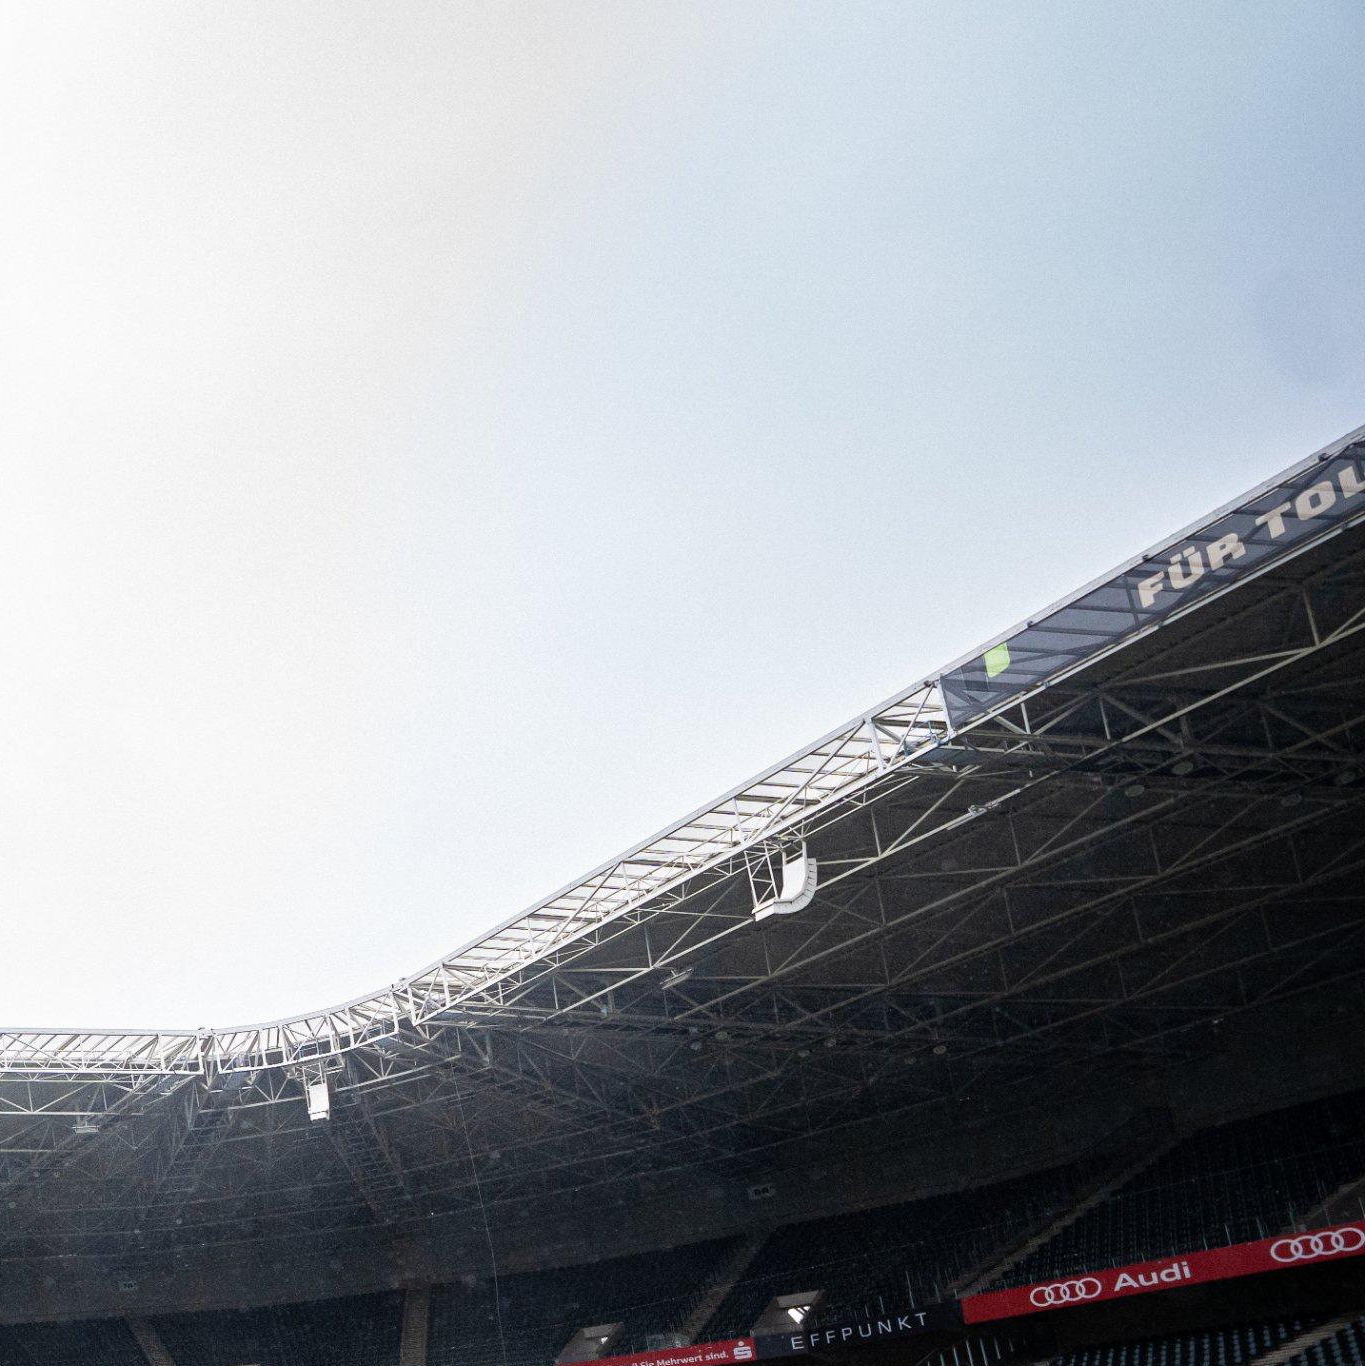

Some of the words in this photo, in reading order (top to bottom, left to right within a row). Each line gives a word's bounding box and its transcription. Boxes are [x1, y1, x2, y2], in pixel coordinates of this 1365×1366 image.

[1137, 533, 1246, 609] FÜR
[1114, 1261, 1191, 1292] Audi
[790, 1312, 927, 1350] EFFPUNKT
[656, 1355, 703, 1366] Mehrwert
